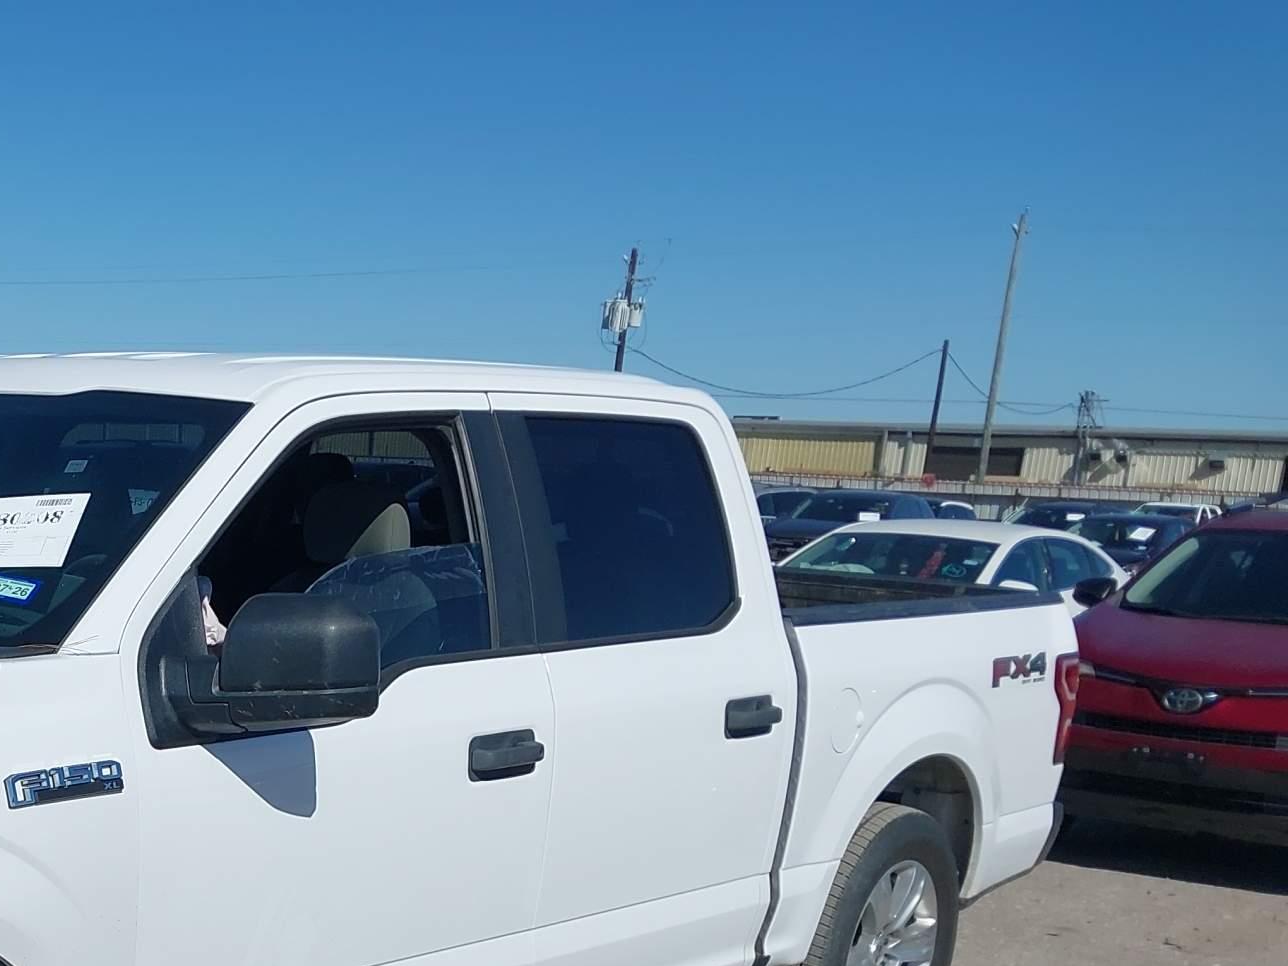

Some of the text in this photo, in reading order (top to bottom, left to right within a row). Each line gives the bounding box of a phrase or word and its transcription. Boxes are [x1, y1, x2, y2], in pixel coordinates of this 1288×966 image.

[12, 586, 30, 597] 26
[991, 651, 1047, 689] FX4
[102, 780, 121, 791] XL
